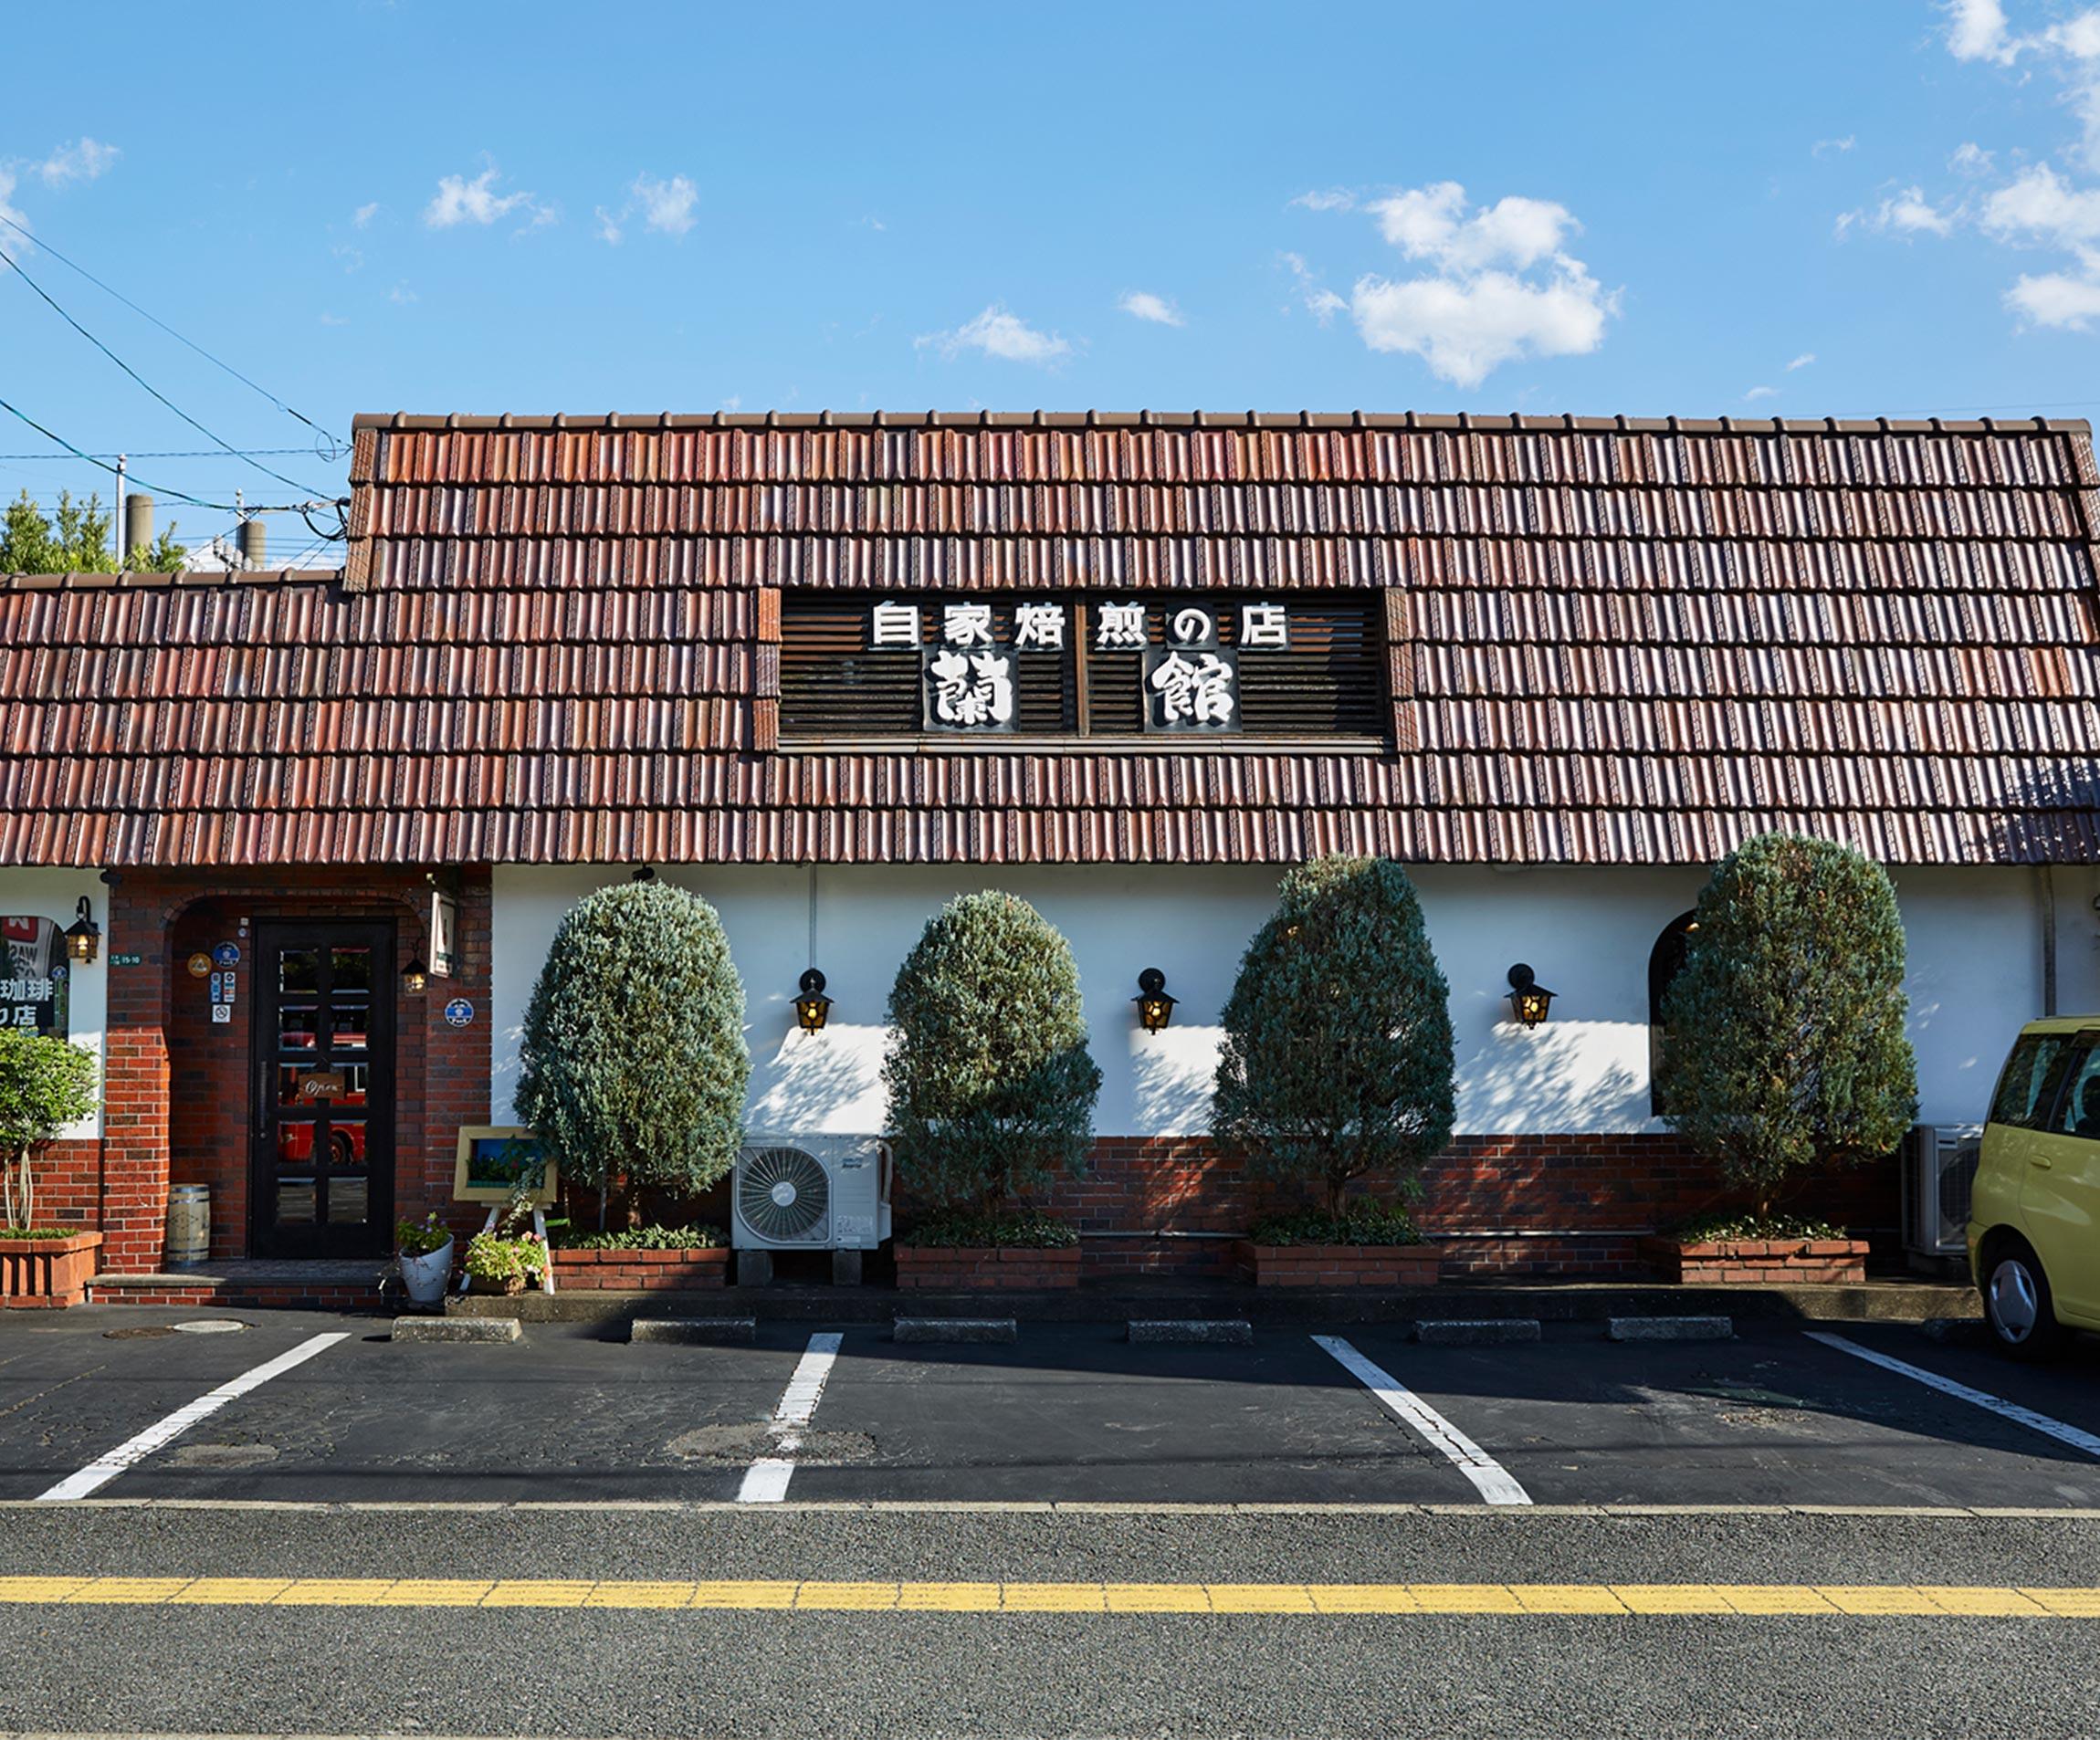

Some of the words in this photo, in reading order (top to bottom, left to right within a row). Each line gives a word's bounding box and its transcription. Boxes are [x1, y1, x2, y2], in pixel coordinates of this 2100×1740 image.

[873, 603, 1286, 647] 自家焙煎の店
[929, 652, 1235, 725] 蘭館
[0, 978, 53, 1001] 珈琲
[305, 1080, 338, 1096] Open
